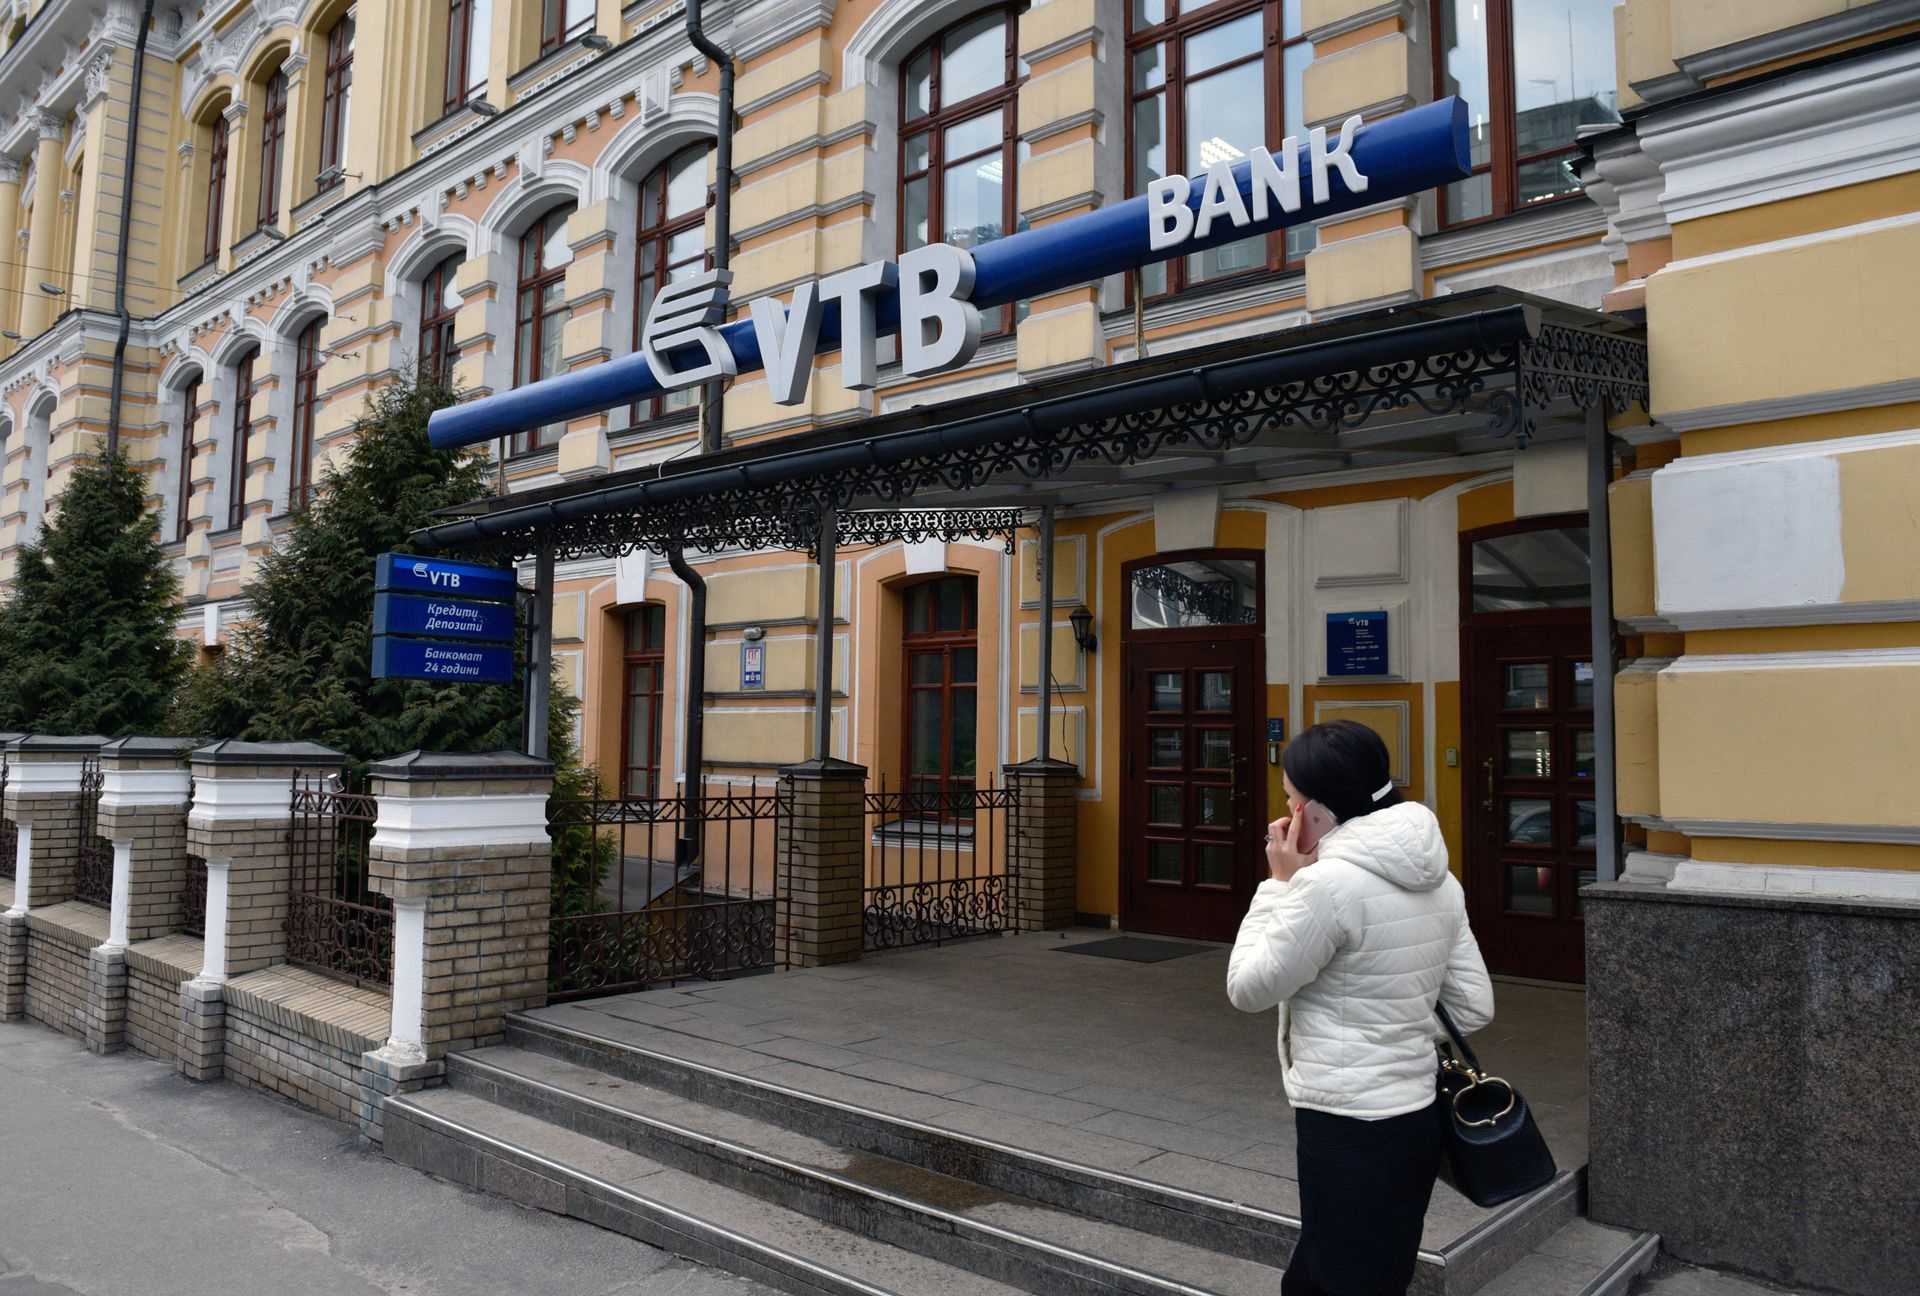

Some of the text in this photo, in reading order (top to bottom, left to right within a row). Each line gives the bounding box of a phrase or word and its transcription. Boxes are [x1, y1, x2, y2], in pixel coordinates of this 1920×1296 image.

[749, 114, 1370, 405] VTB BANK
[429, 570, 460, 587] VTB
[427, 603, 478, 618] Кредити
[425, 617, 483, 632] Депозити
[425, 648, 482, 661] Банкомат
[424, 662, 480, 675] 24 години
